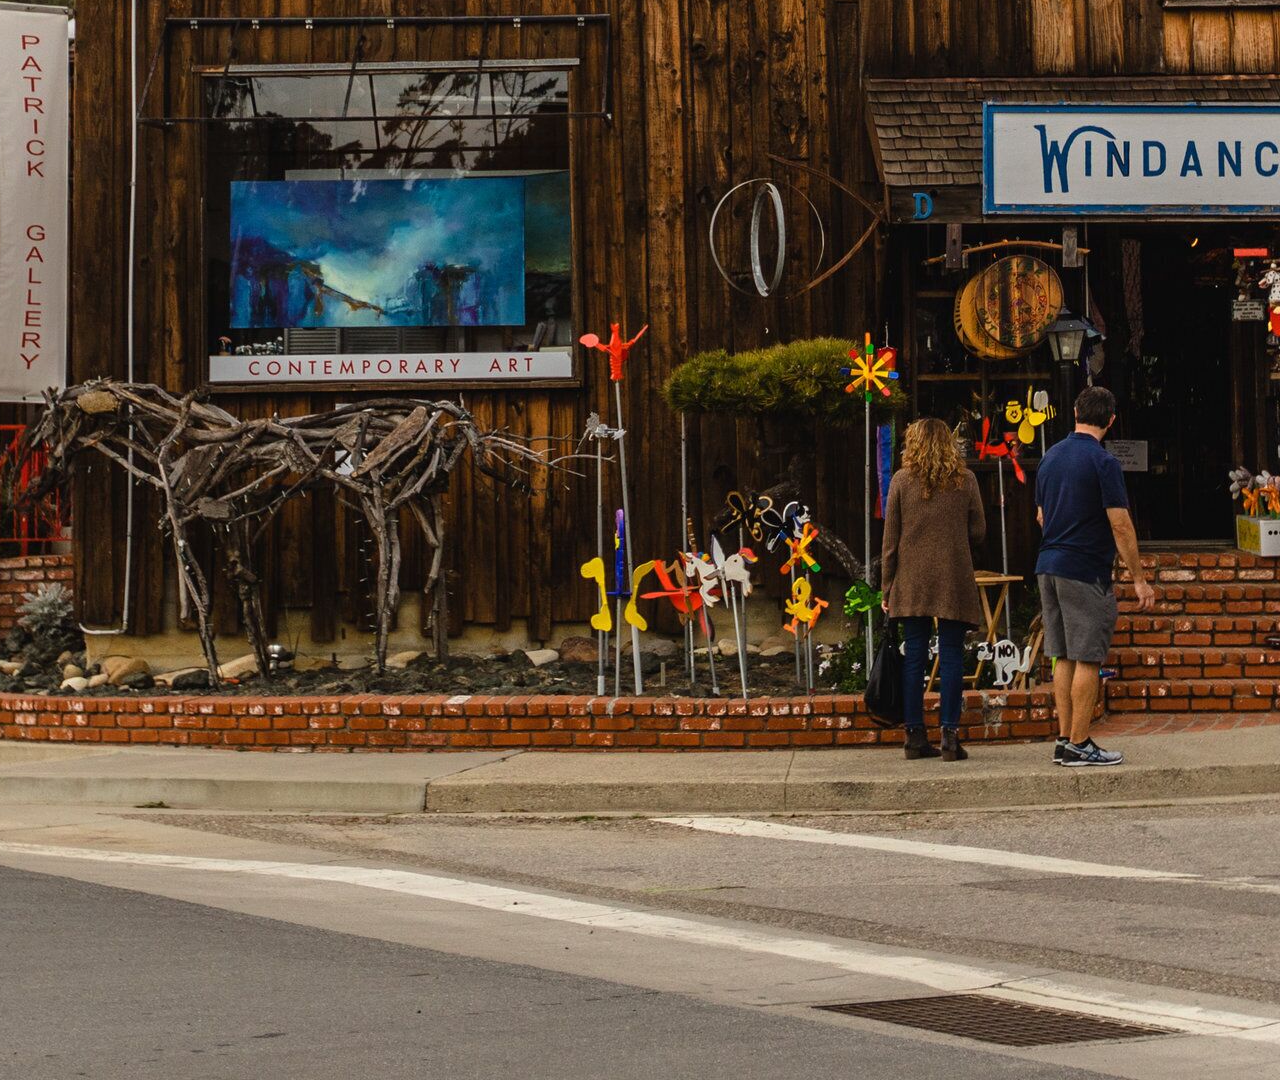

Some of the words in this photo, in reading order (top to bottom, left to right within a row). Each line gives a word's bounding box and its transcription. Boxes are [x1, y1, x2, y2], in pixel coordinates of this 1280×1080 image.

[20, 34, 45, 178] PATRICK
[19, 224, 46, 370] GALLERY
[248, 358, 461, 376] CONTEMPORARY
[488, 357, 534, 373] ART
[999, 644, 1015, 658] NO!
